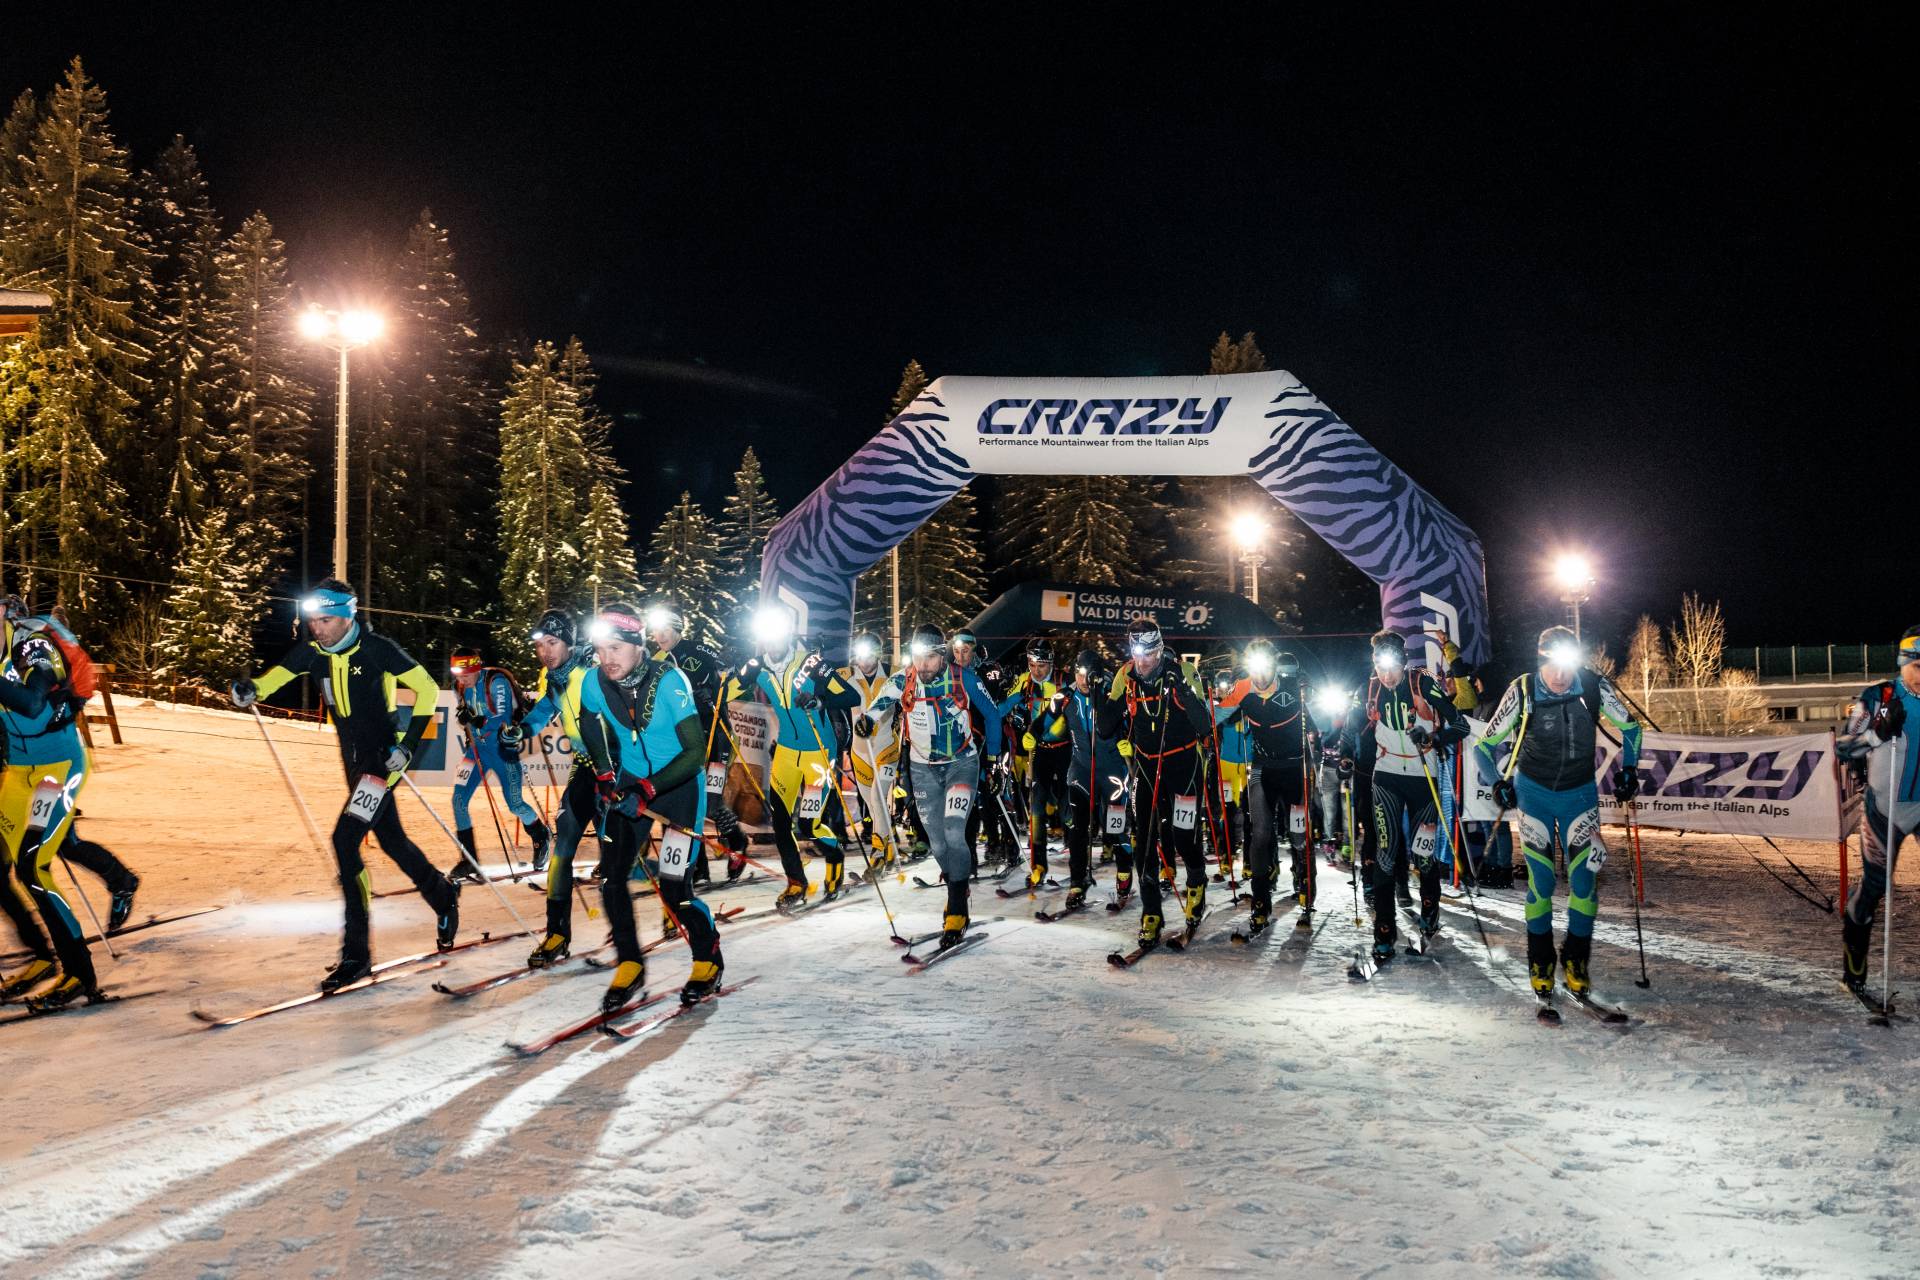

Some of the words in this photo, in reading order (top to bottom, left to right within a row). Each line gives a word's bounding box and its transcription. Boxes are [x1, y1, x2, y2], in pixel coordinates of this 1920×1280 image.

[977, 396, 1233, 435] CRAZY
[978, 437, 1039, 446] Performance
[1041, 437, 1109, 446] Mountainwear
[1111, 438, 1133, 446] from
[1136, 437, 1153, 446] the
[1155, 437, 1185, 446] Italian
[1187, 437, 1209, 448] Alps
[1078, 592, 1122, 606] CASSA
[1125, 595, 1175, 609] RURALE
[1078, 606, 1103, 619] VAL
[1106, 607, 1120, 620] DI
[1122, 609, 1157, 621] SOLE
[706, 774, 724, 788] 230
[353, 790, 380, 813] 203
[801, 798, 820, 812] 228
[948, 796, 969, 812] 182
[1653, 800, 1684, 812] from
[1688, 801, 1710, 811] the
[1714, 801, 1755, 814] Italian
[1759, 804, 1790, 818] Alps
[1110, 817, 1123, 829] 29
[1175, 808, 1194, 823] 171
[1415, 836, 1435, 852] 198
[663, 846, 682, 866] 36
